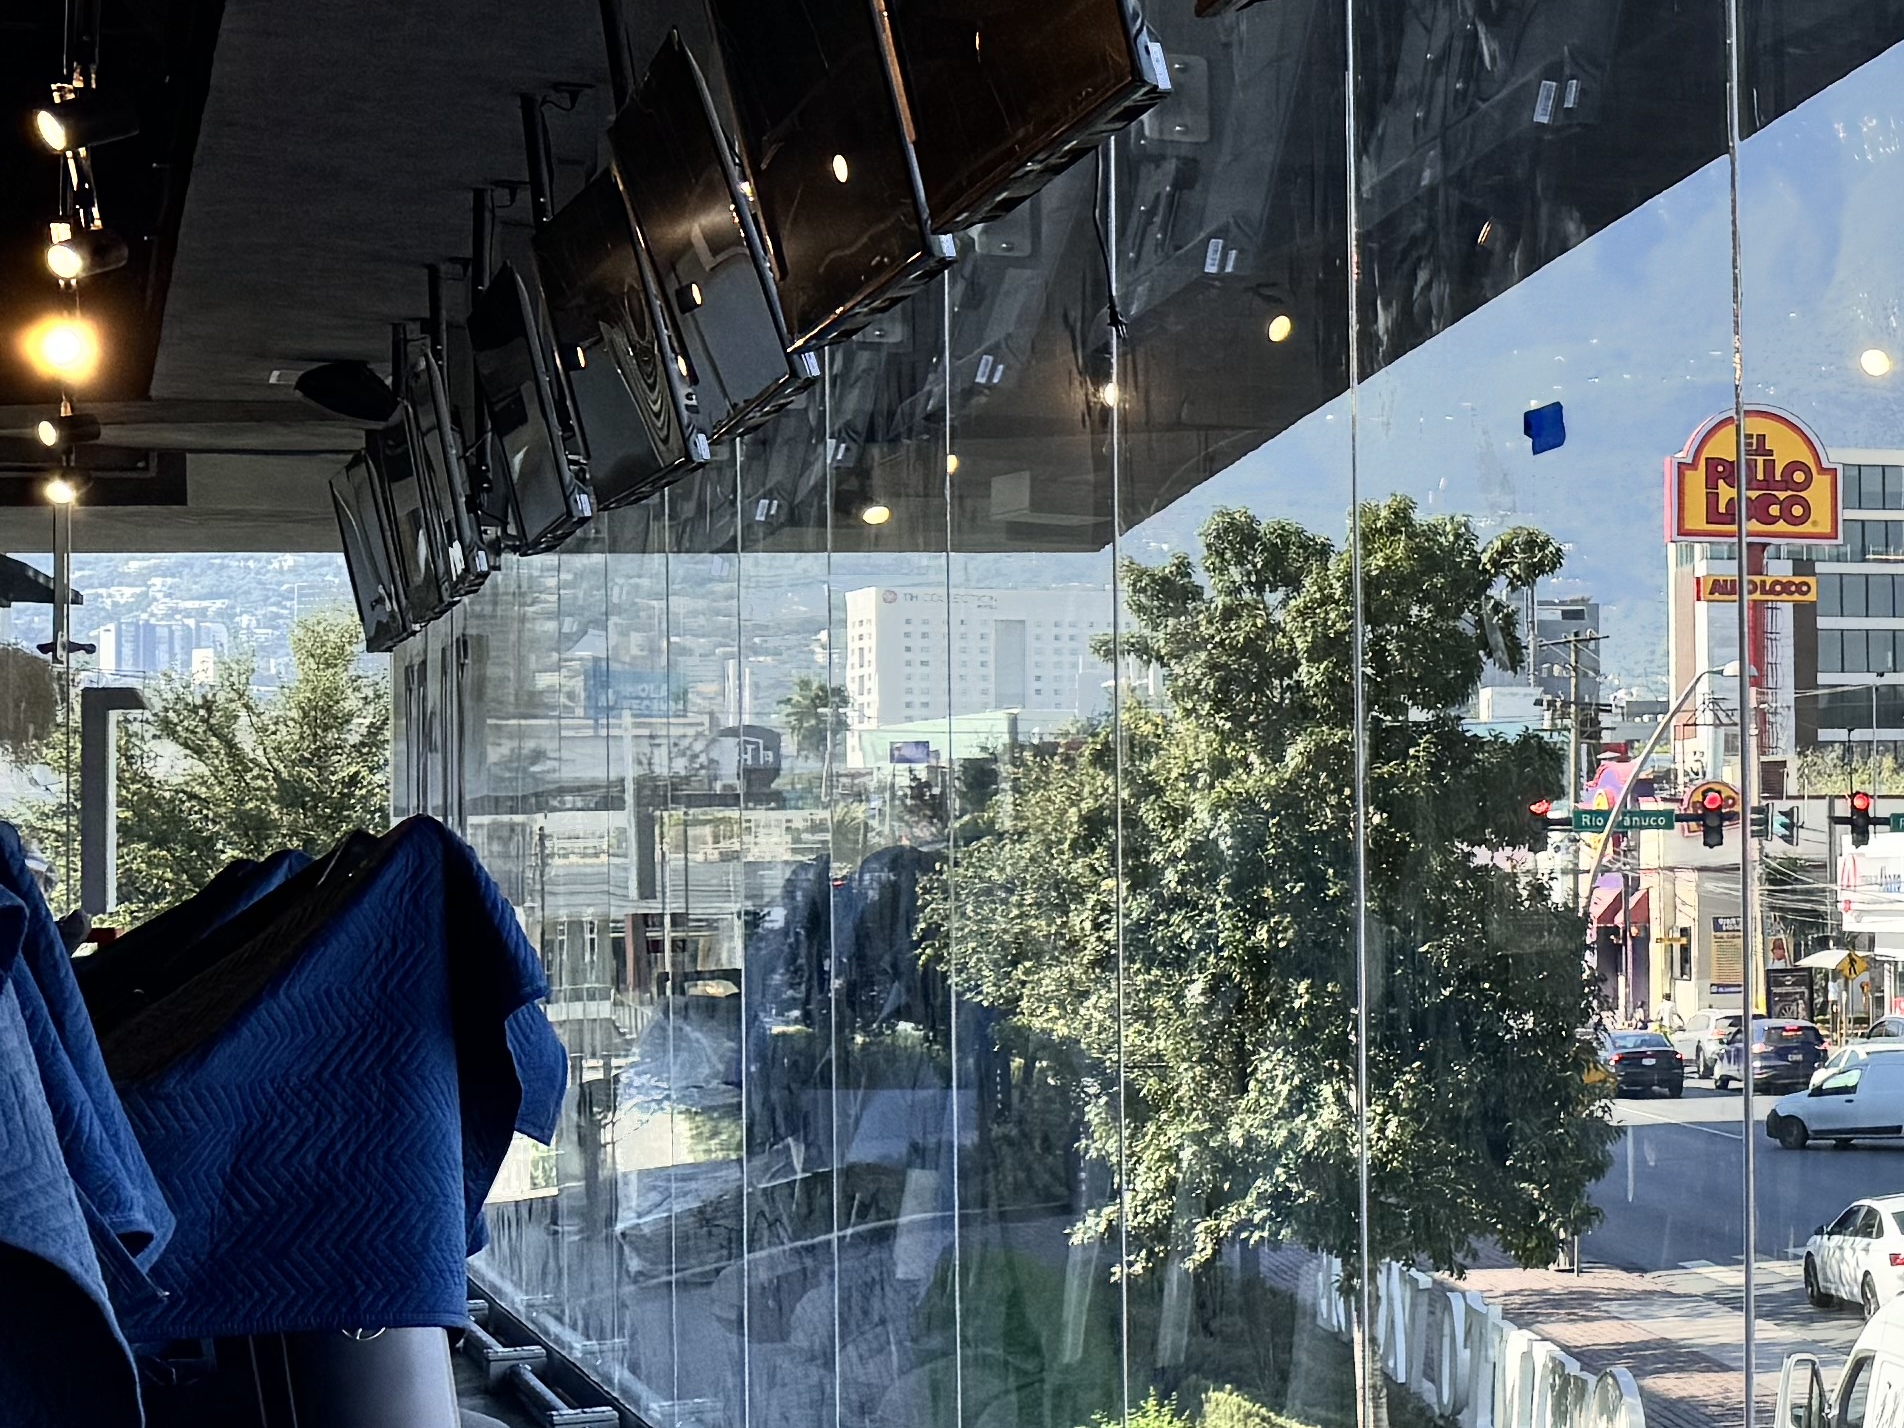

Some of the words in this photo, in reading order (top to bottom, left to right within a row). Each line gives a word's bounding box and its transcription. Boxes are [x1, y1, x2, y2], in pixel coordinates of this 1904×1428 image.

[1742, 433, 1774, 456] EL
[1759, 578, 1811, 597] LOCO
[1618, 813, 1666, 826] ánuco
